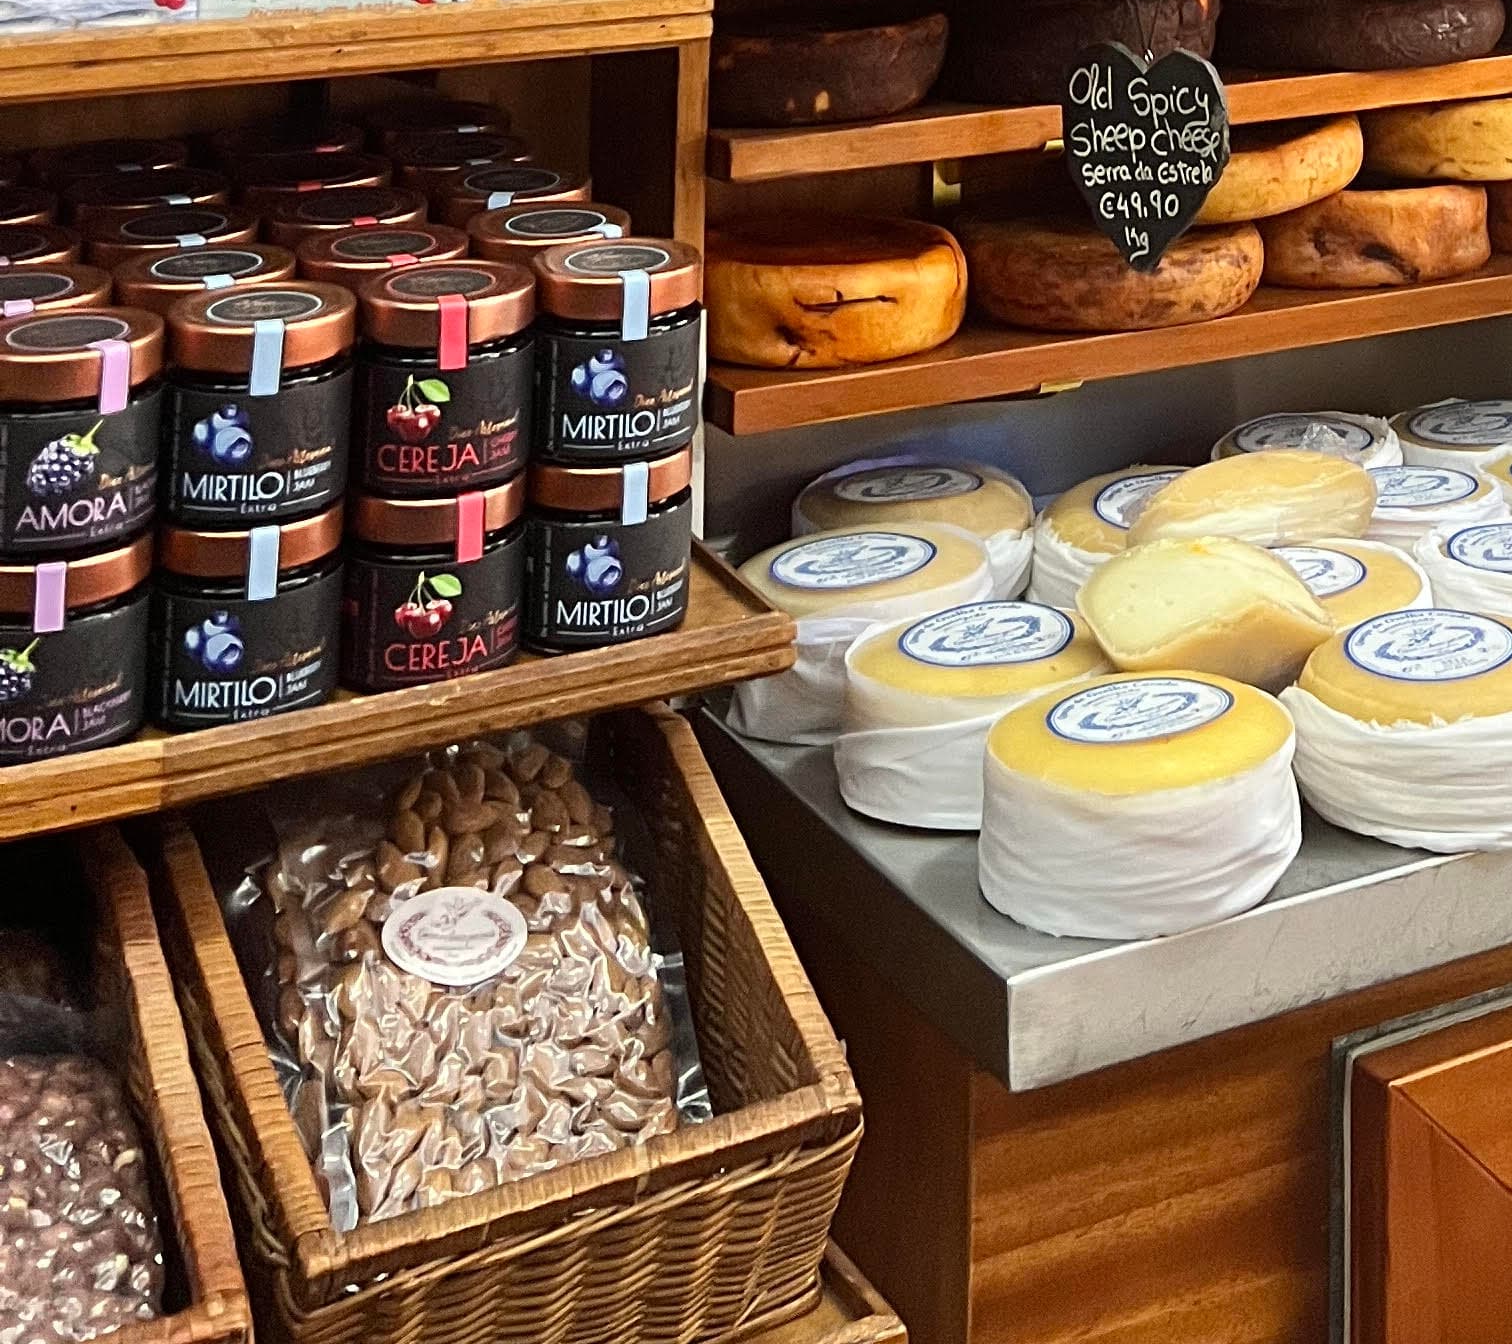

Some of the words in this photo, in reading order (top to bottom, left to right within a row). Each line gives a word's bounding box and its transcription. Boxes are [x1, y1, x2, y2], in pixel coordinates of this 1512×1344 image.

[1068, 62, 1114, 112] Old
[1126, 76, 1211, 130] Spicy
[1070, 117, 1147, 164] Sheep
[1134, 159, 1155, 182] da
[561, 409, 657, 441] MIRTILO
[377, 442, 481, 474] CEREJA
[616, 438, 651, 452] Extra
[182, 470, 286, 502] MIRTILO
[14, 490, 129, 532] AMORA
[239, 502, 278, 515] Extra
[555, 593, 651, 626] MIRTILO
[611, 624, 645, 637] Extra
[383, 633, 489, 672] CEREJA
[173, 675, 278, 709] MIRTILO
